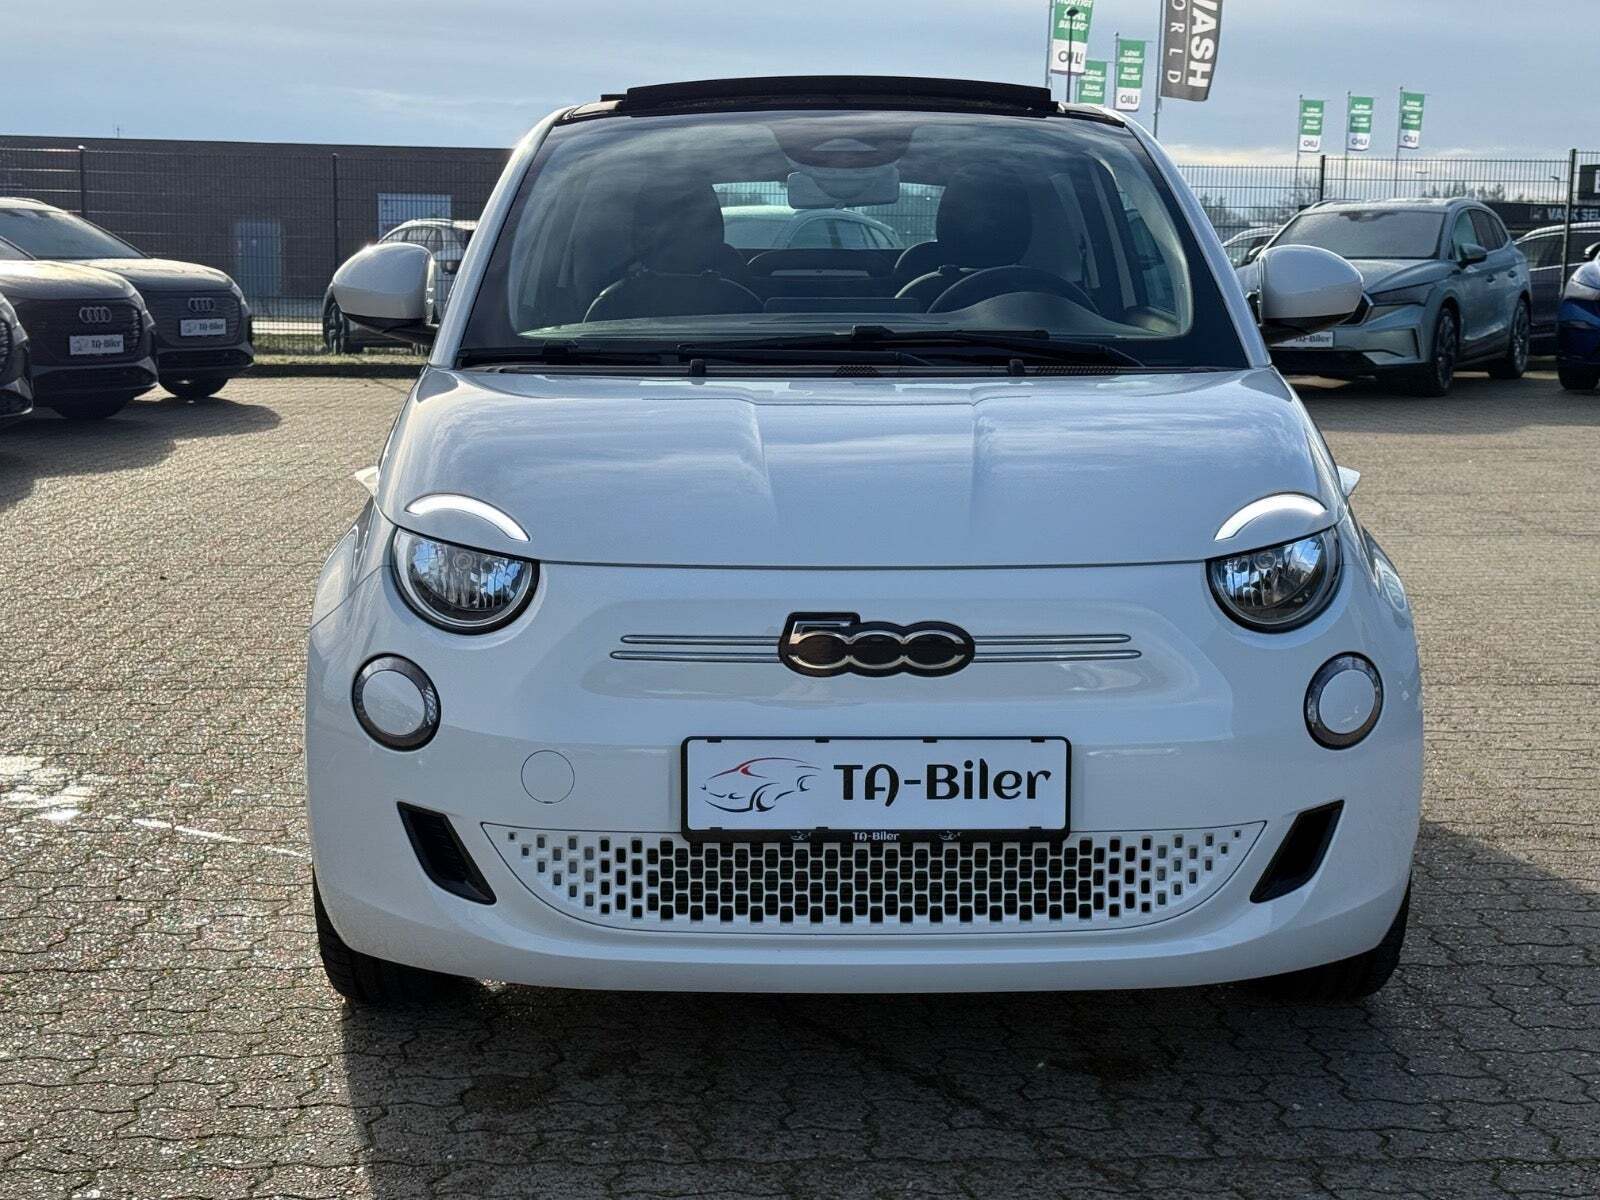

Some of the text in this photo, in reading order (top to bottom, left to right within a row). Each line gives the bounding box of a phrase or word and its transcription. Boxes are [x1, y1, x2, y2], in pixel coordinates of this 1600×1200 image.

[782, 614, 972, 676] 500
[833, 758, 1052, 807] TA-Biler
[853, 831, 900, 842] TA-Biler
